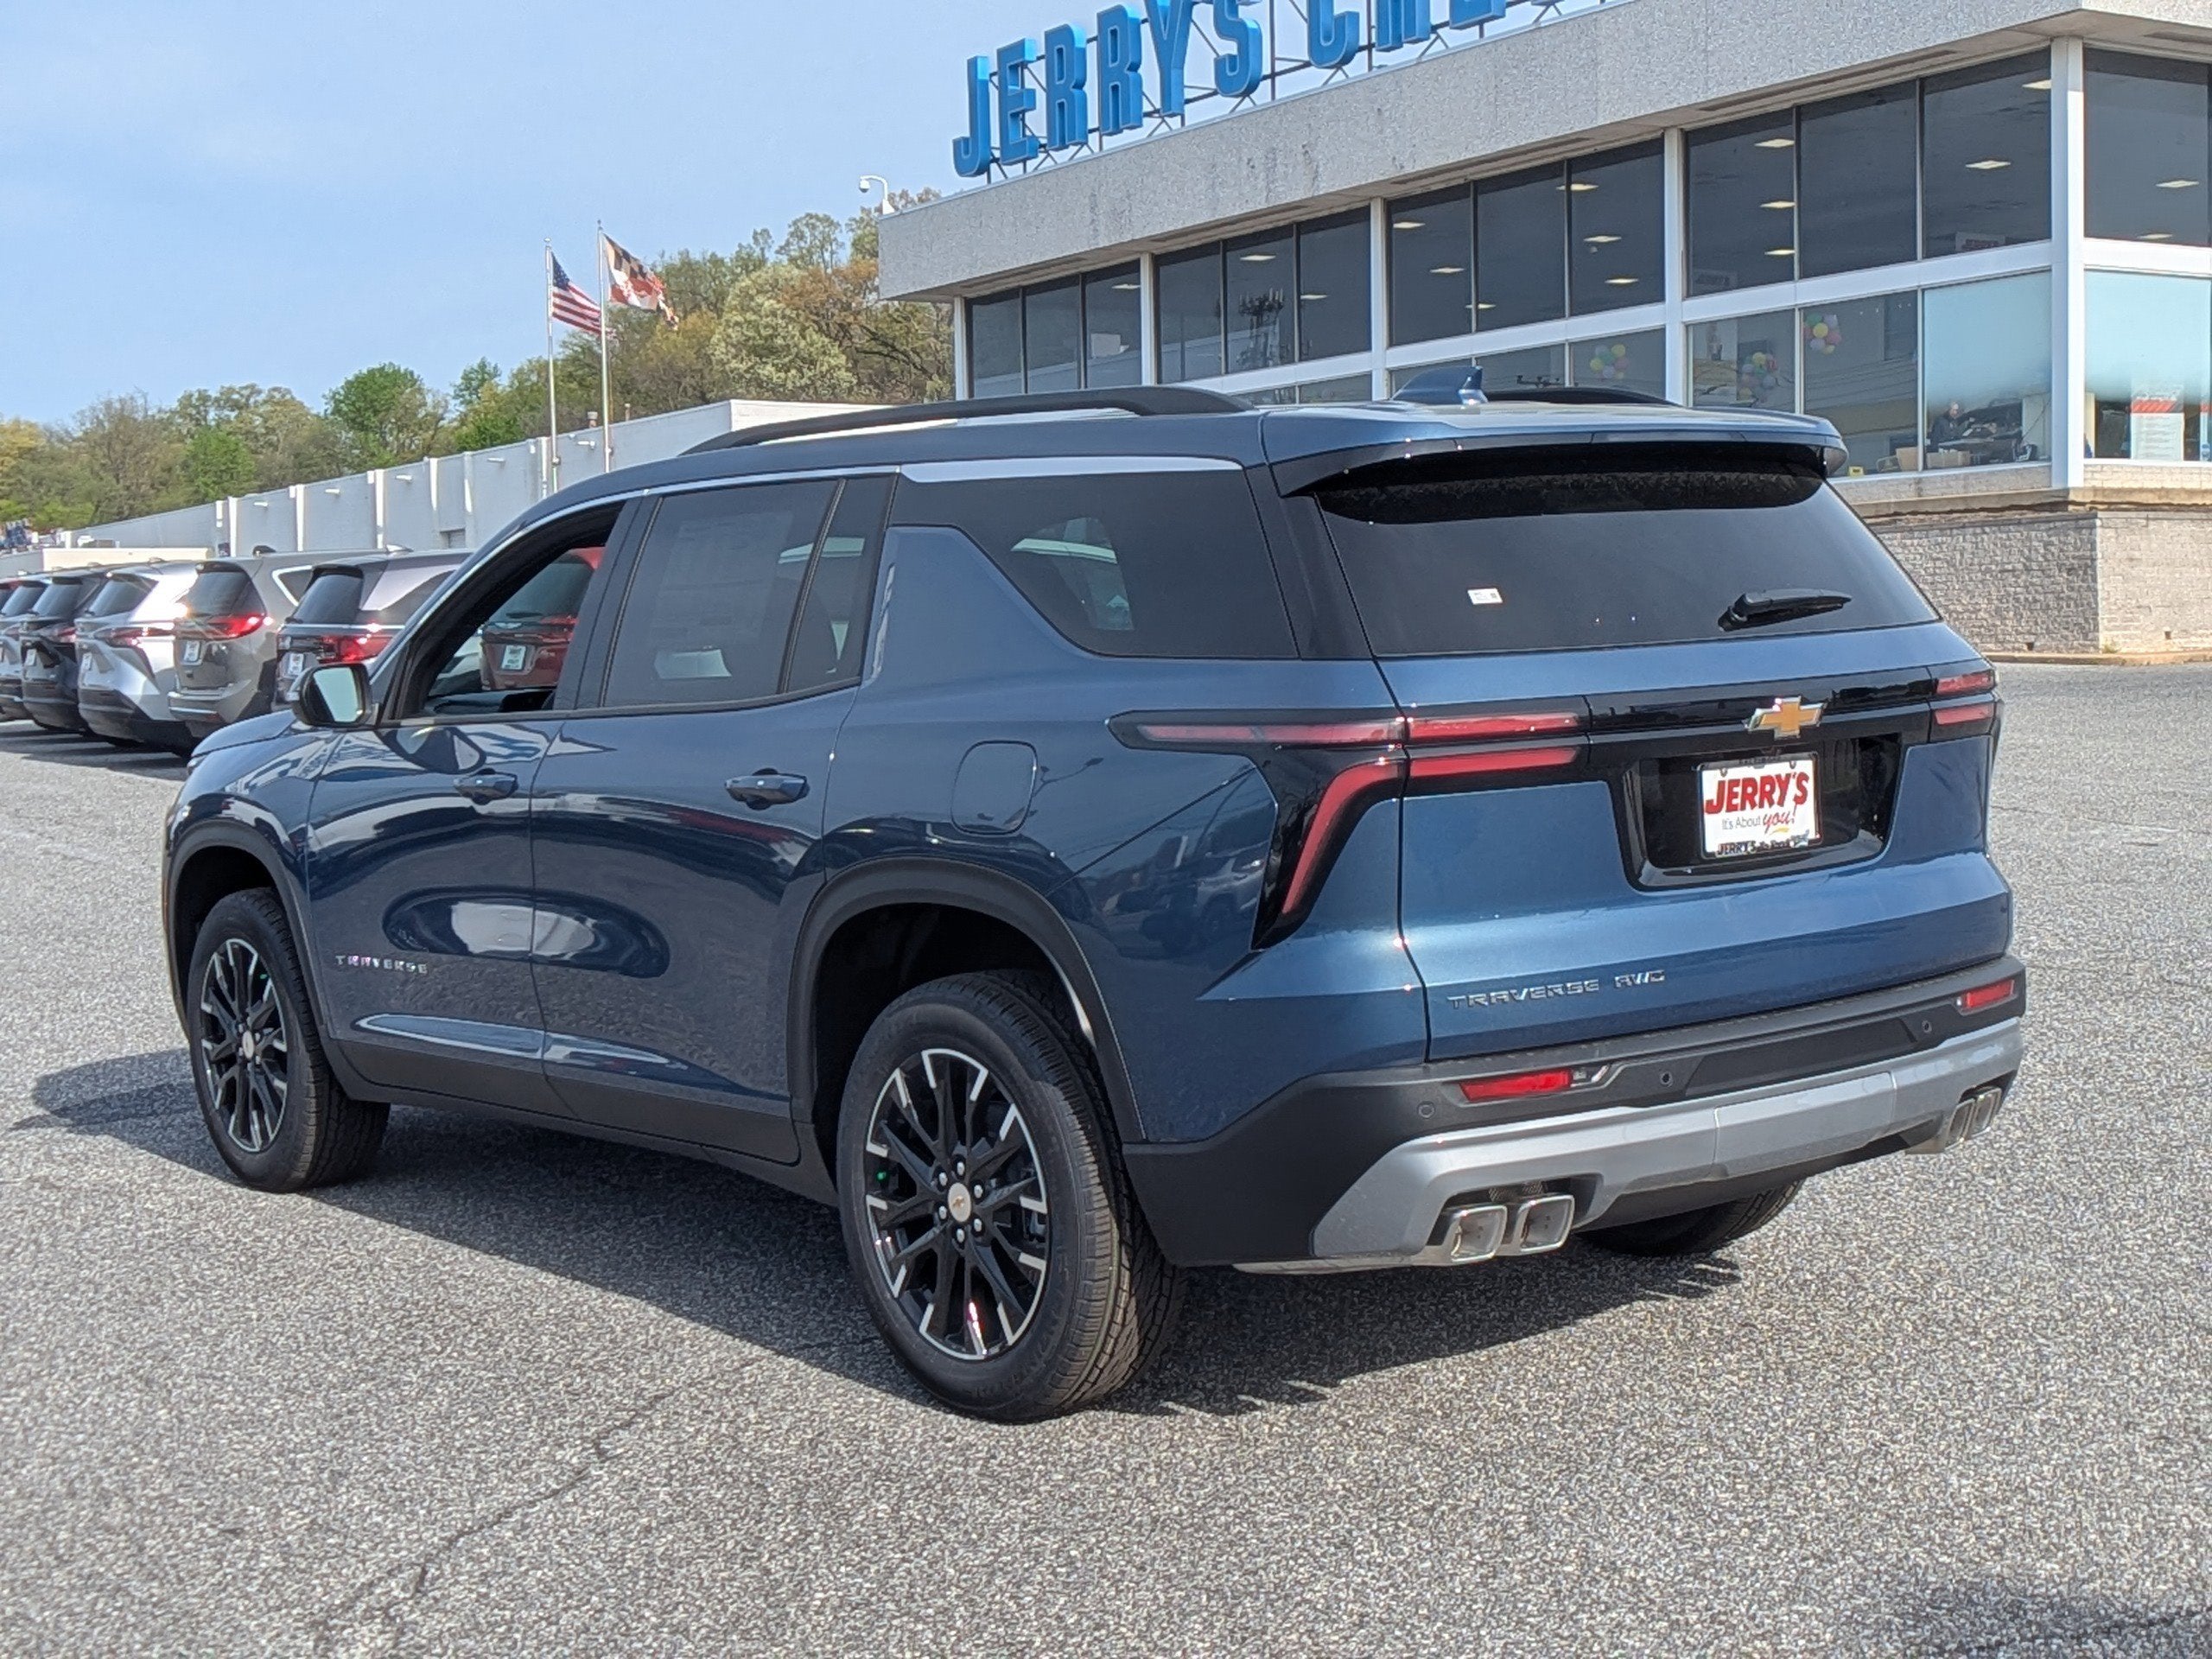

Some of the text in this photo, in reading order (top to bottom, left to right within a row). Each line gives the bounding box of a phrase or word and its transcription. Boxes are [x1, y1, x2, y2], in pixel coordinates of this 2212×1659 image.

[1705, 772, 1809, 814] JERRY'S
[1736, 817, 1761, 829] About
[335, 956, 428, 974] TRAVERSE
[1447, 969, 1666, 1008] TRAVERSE AWD
